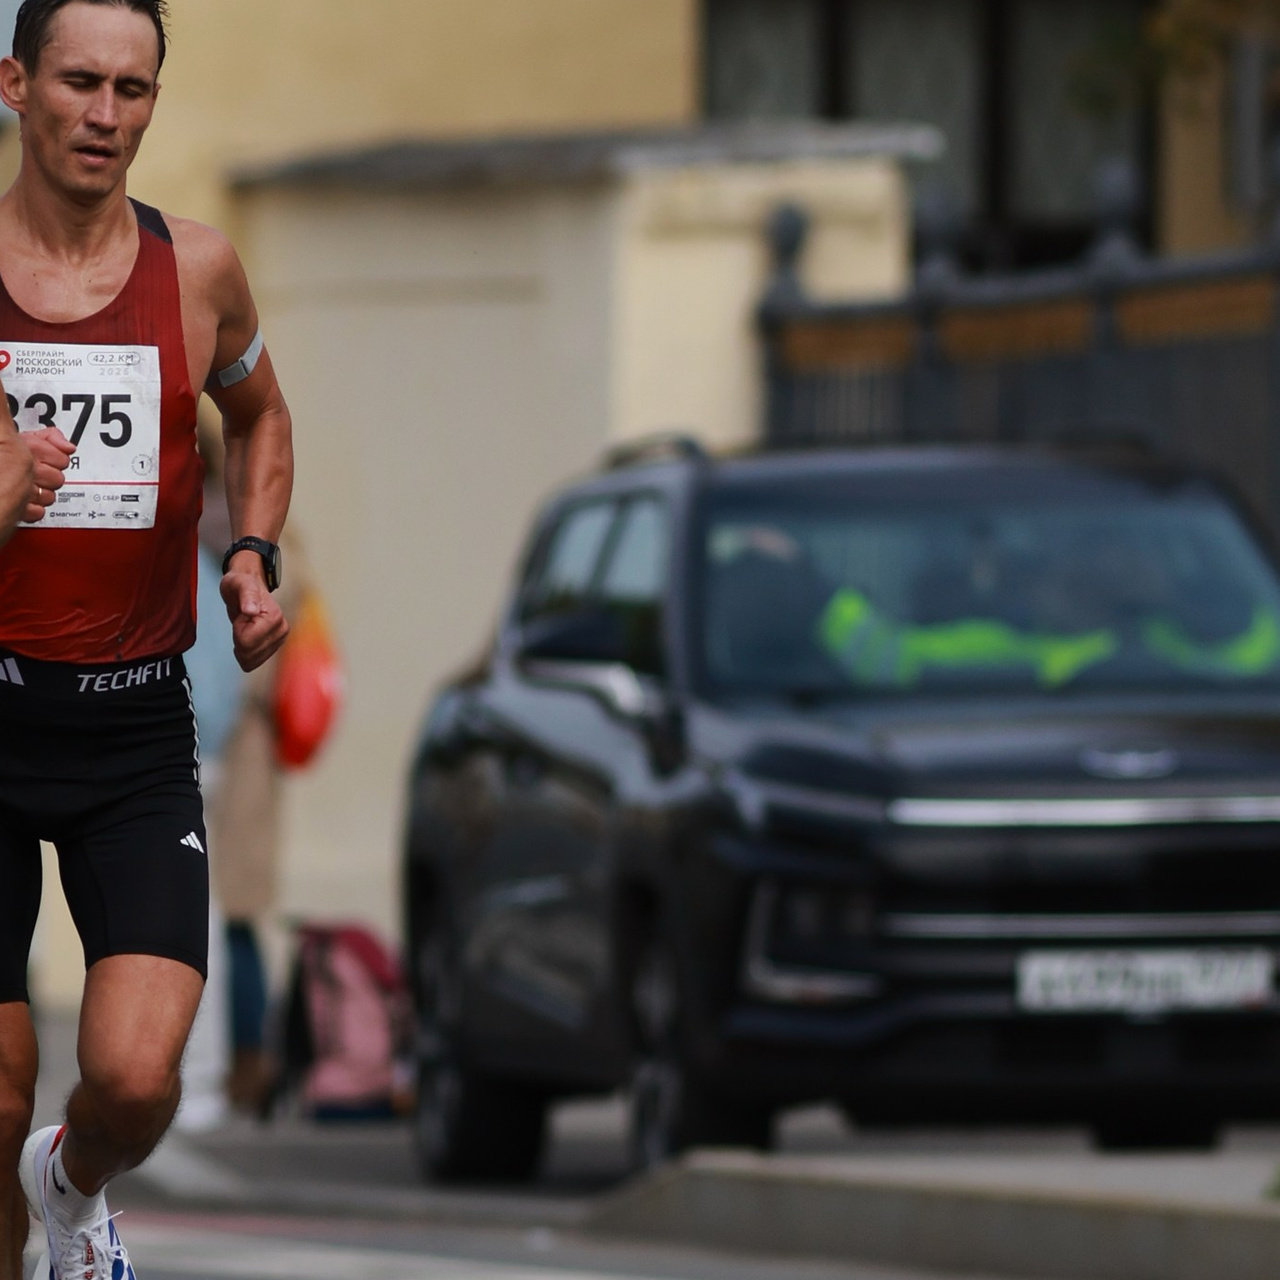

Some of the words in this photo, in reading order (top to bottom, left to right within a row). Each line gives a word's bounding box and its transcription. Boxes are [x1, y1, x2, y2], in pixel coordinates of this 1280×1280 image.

[16, 357, 83, 367] МОСКОВСКИЙ
[93, 354, 115, 363] 42,2
[15, 366, 65, 375] МАРАФОН
[138, 460, 145, 469] 1
[77, 658, 172, 692] TECHFIT
